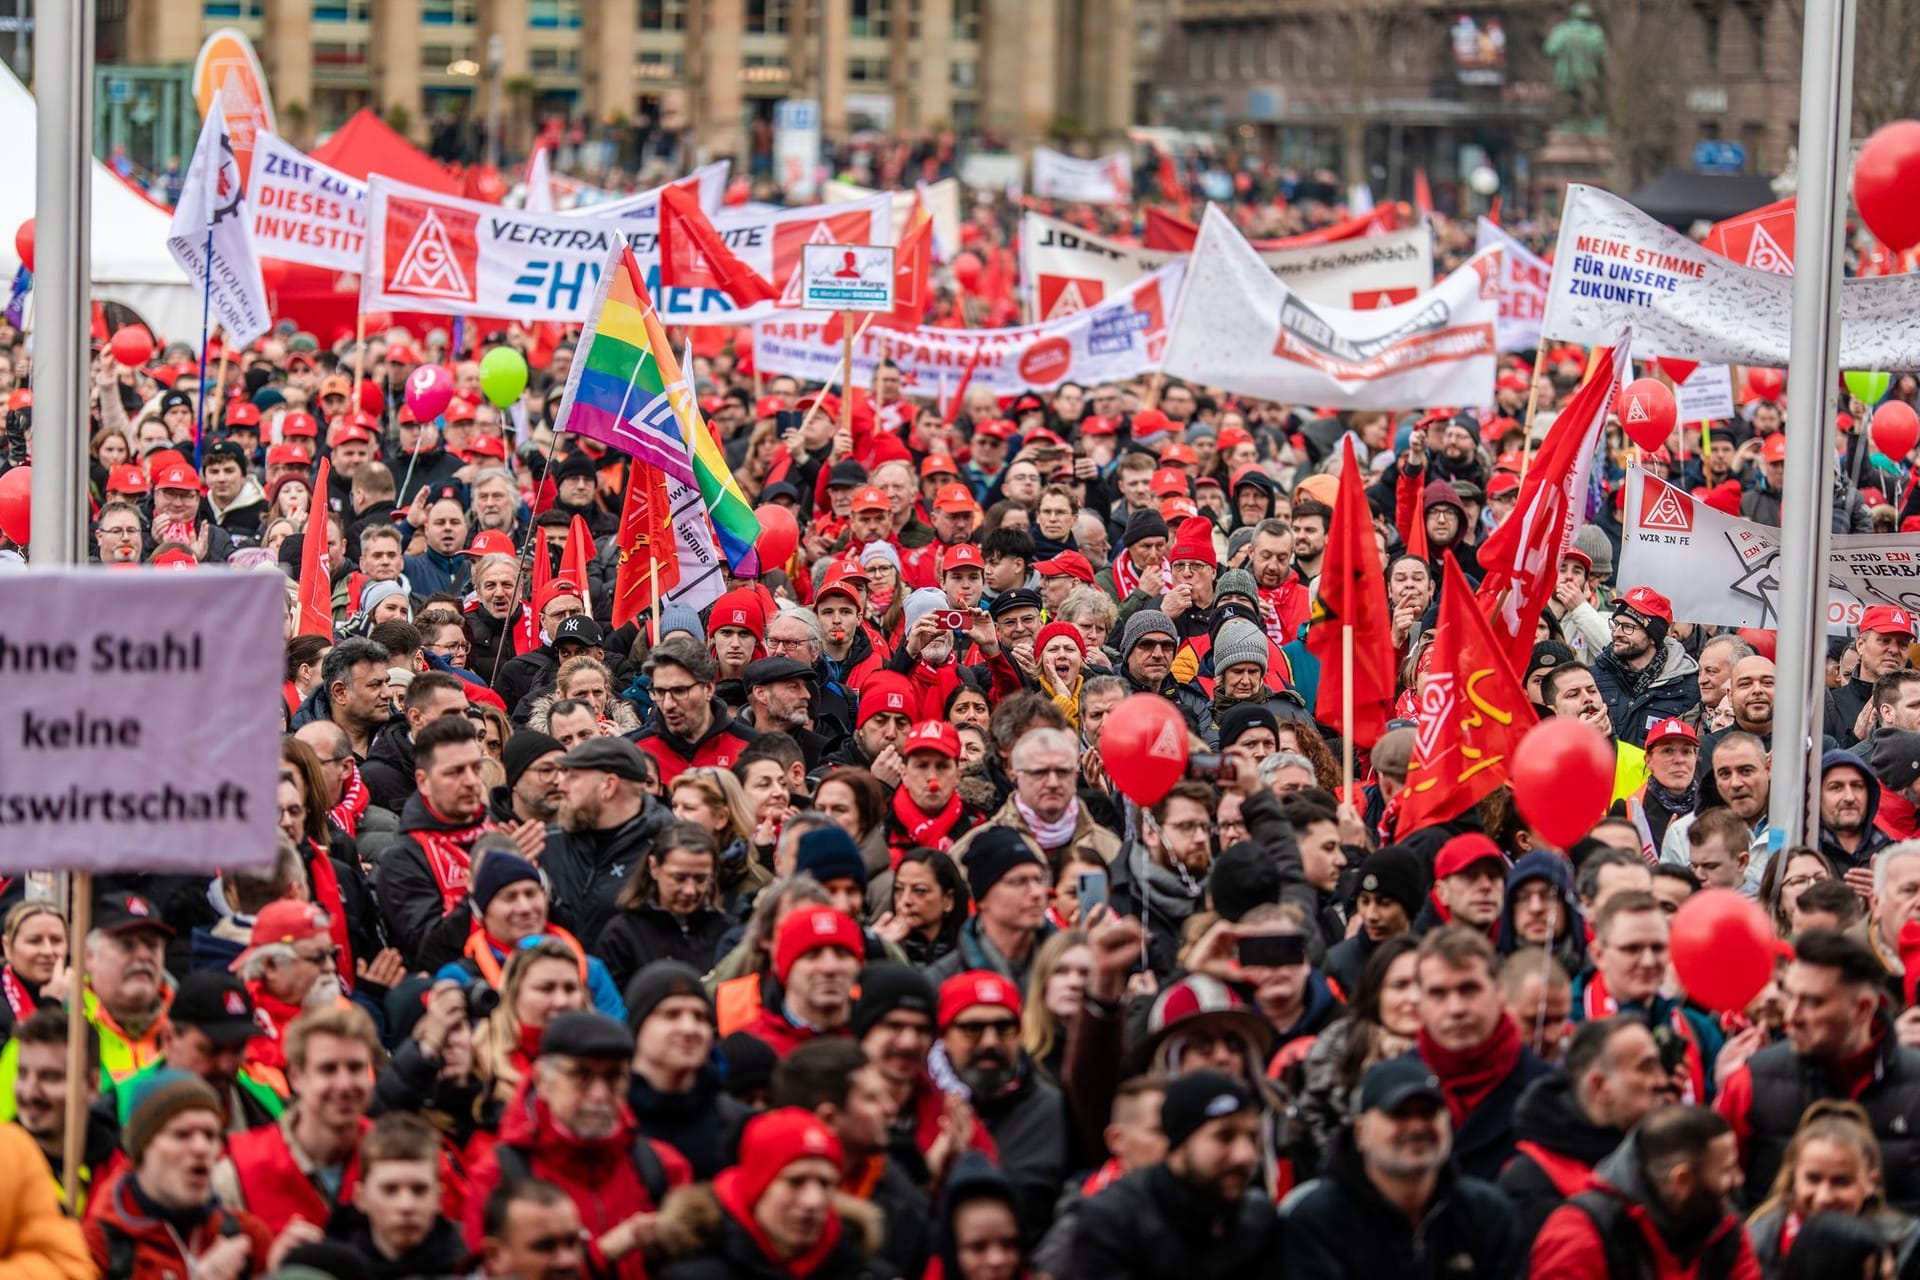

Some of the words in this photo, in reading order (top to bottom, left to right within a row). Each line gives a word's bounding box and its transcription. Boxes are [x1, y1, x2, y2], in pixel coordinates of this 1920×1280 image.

[264, 153, 314, 183] ZEIT
[320, 175, 349, 197] ZU
[260, 186, 341, 220] DIESES
[254, 215, 364, 254] INVESTIT
[1573, 255, 1604, 277] FÜR
[1609, 263, 1678, 292] UNSERE
[1576, 235, 1631, 260] MEINE
[1635, 248, 1707, 279] STIMME
[1569, 278, 1653, 308] ZUKUNFT!
[677, 522, 710, 565] sismus
[1639, 533, 1660, 543] WIR
[1664, 536, 1677, 545] IN
[1680, 536, 1691, 546] FE
[1743, 545, 1761, 560] EIN
[1850, 553, 1881, 562] SIND
[1885, 552, 1911, 562] EIN
[0, 632, 77, 674] hne
[91, 630, 204, 674] Stahl
[22, 707, 142, 749] keine
[0, 779, 249, 826] swirtschaft
